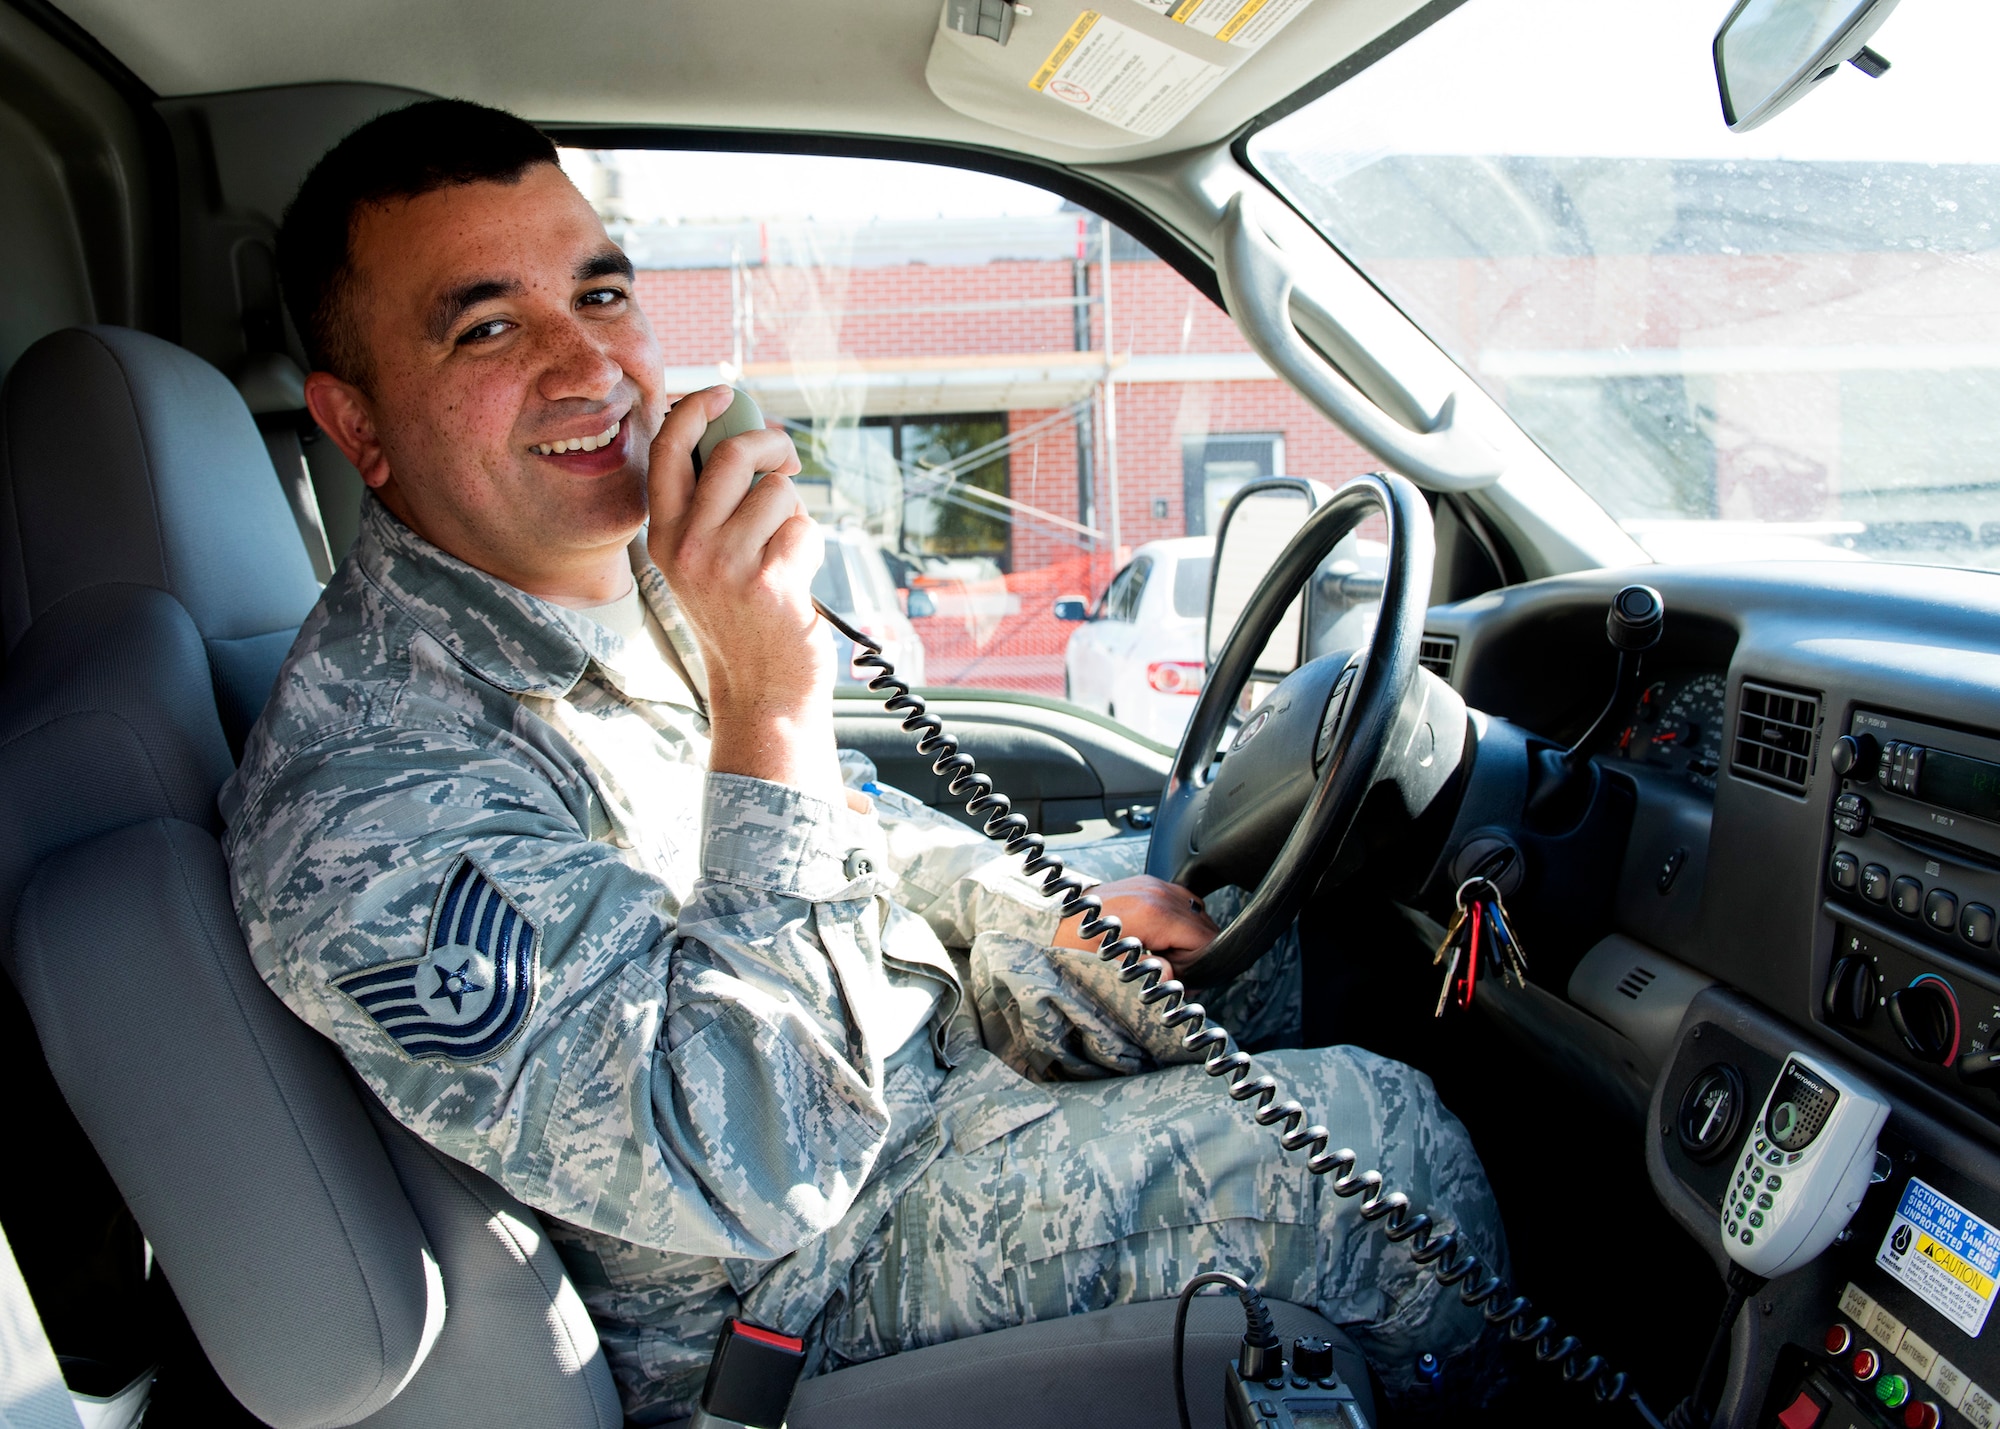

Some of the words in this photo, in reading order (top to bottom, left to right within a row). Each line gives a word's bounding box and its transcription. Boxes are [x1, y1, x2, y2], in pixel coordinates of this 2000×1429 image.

[1868, 716, 1880, 727] PUSH
[1880, 721, 1887, 729] ON
[1882, 753, 1890, 761] FM
[1878, 770, 1886, 779] CD
[1937, 815, 1948, 825] DISC
[1866, 884, 1872, 894] 2
[1898, 897, 1903, 908] 3
[1931, 911, 1937, 921] 4
[1967, 925, 1974, 937] 5
[1977, 1021, 1989, 1033] A/C
[1971, 1039, 1985, 1051] MAX
[1794, 1071, 1824, 1094] MOTOROLA
[1912, 1186, 1962, 1222] ACTIVATION
[1965, 1219, 1978, 1233] OF
[1908, 1195, 1932, 1217] SIREN
[1938, 1213, 1957, 1232] MAY
[1961, 1230, 2000, 1262] DAMAGE
[1903, 1206, 1963, 1251] UNPROTECTED
[1967, 1249, 1994, 1273] EARS!
[1913, 1252, 1927, 1265] Loud
[1927, 1263, 1939, 1275] siren
[1939, 1272, 1954, 1285] noise
[1954, 1283, 1964, 1292] can
[1964, 1290, 1981, 1305] cause
[1934, 1247, 1983, 1291] CAUTION
[1910, 1260, 1929, 1280] hearing
[1929, 1274, 1948, 1292] damage
[1948, 1289, 1966, 1304] and/or
[1966, 1301, 1977, 1314] loss
[1848, 1289, 1867, 1309] DOOR
[1844, 1302, 1862, 1320] AJAR
[1873, 1325, 1891, 1344] AJAR
[1902, 1340, 1928, 1368] BATTERIES
[1940, 1365, 1959, 1386] CODE
[1936, 1378, 1950, 1395] RED
[1972, 1392, 1993, 1414] CODE
[1963, 1400, 1992, 1429] YELLOW
